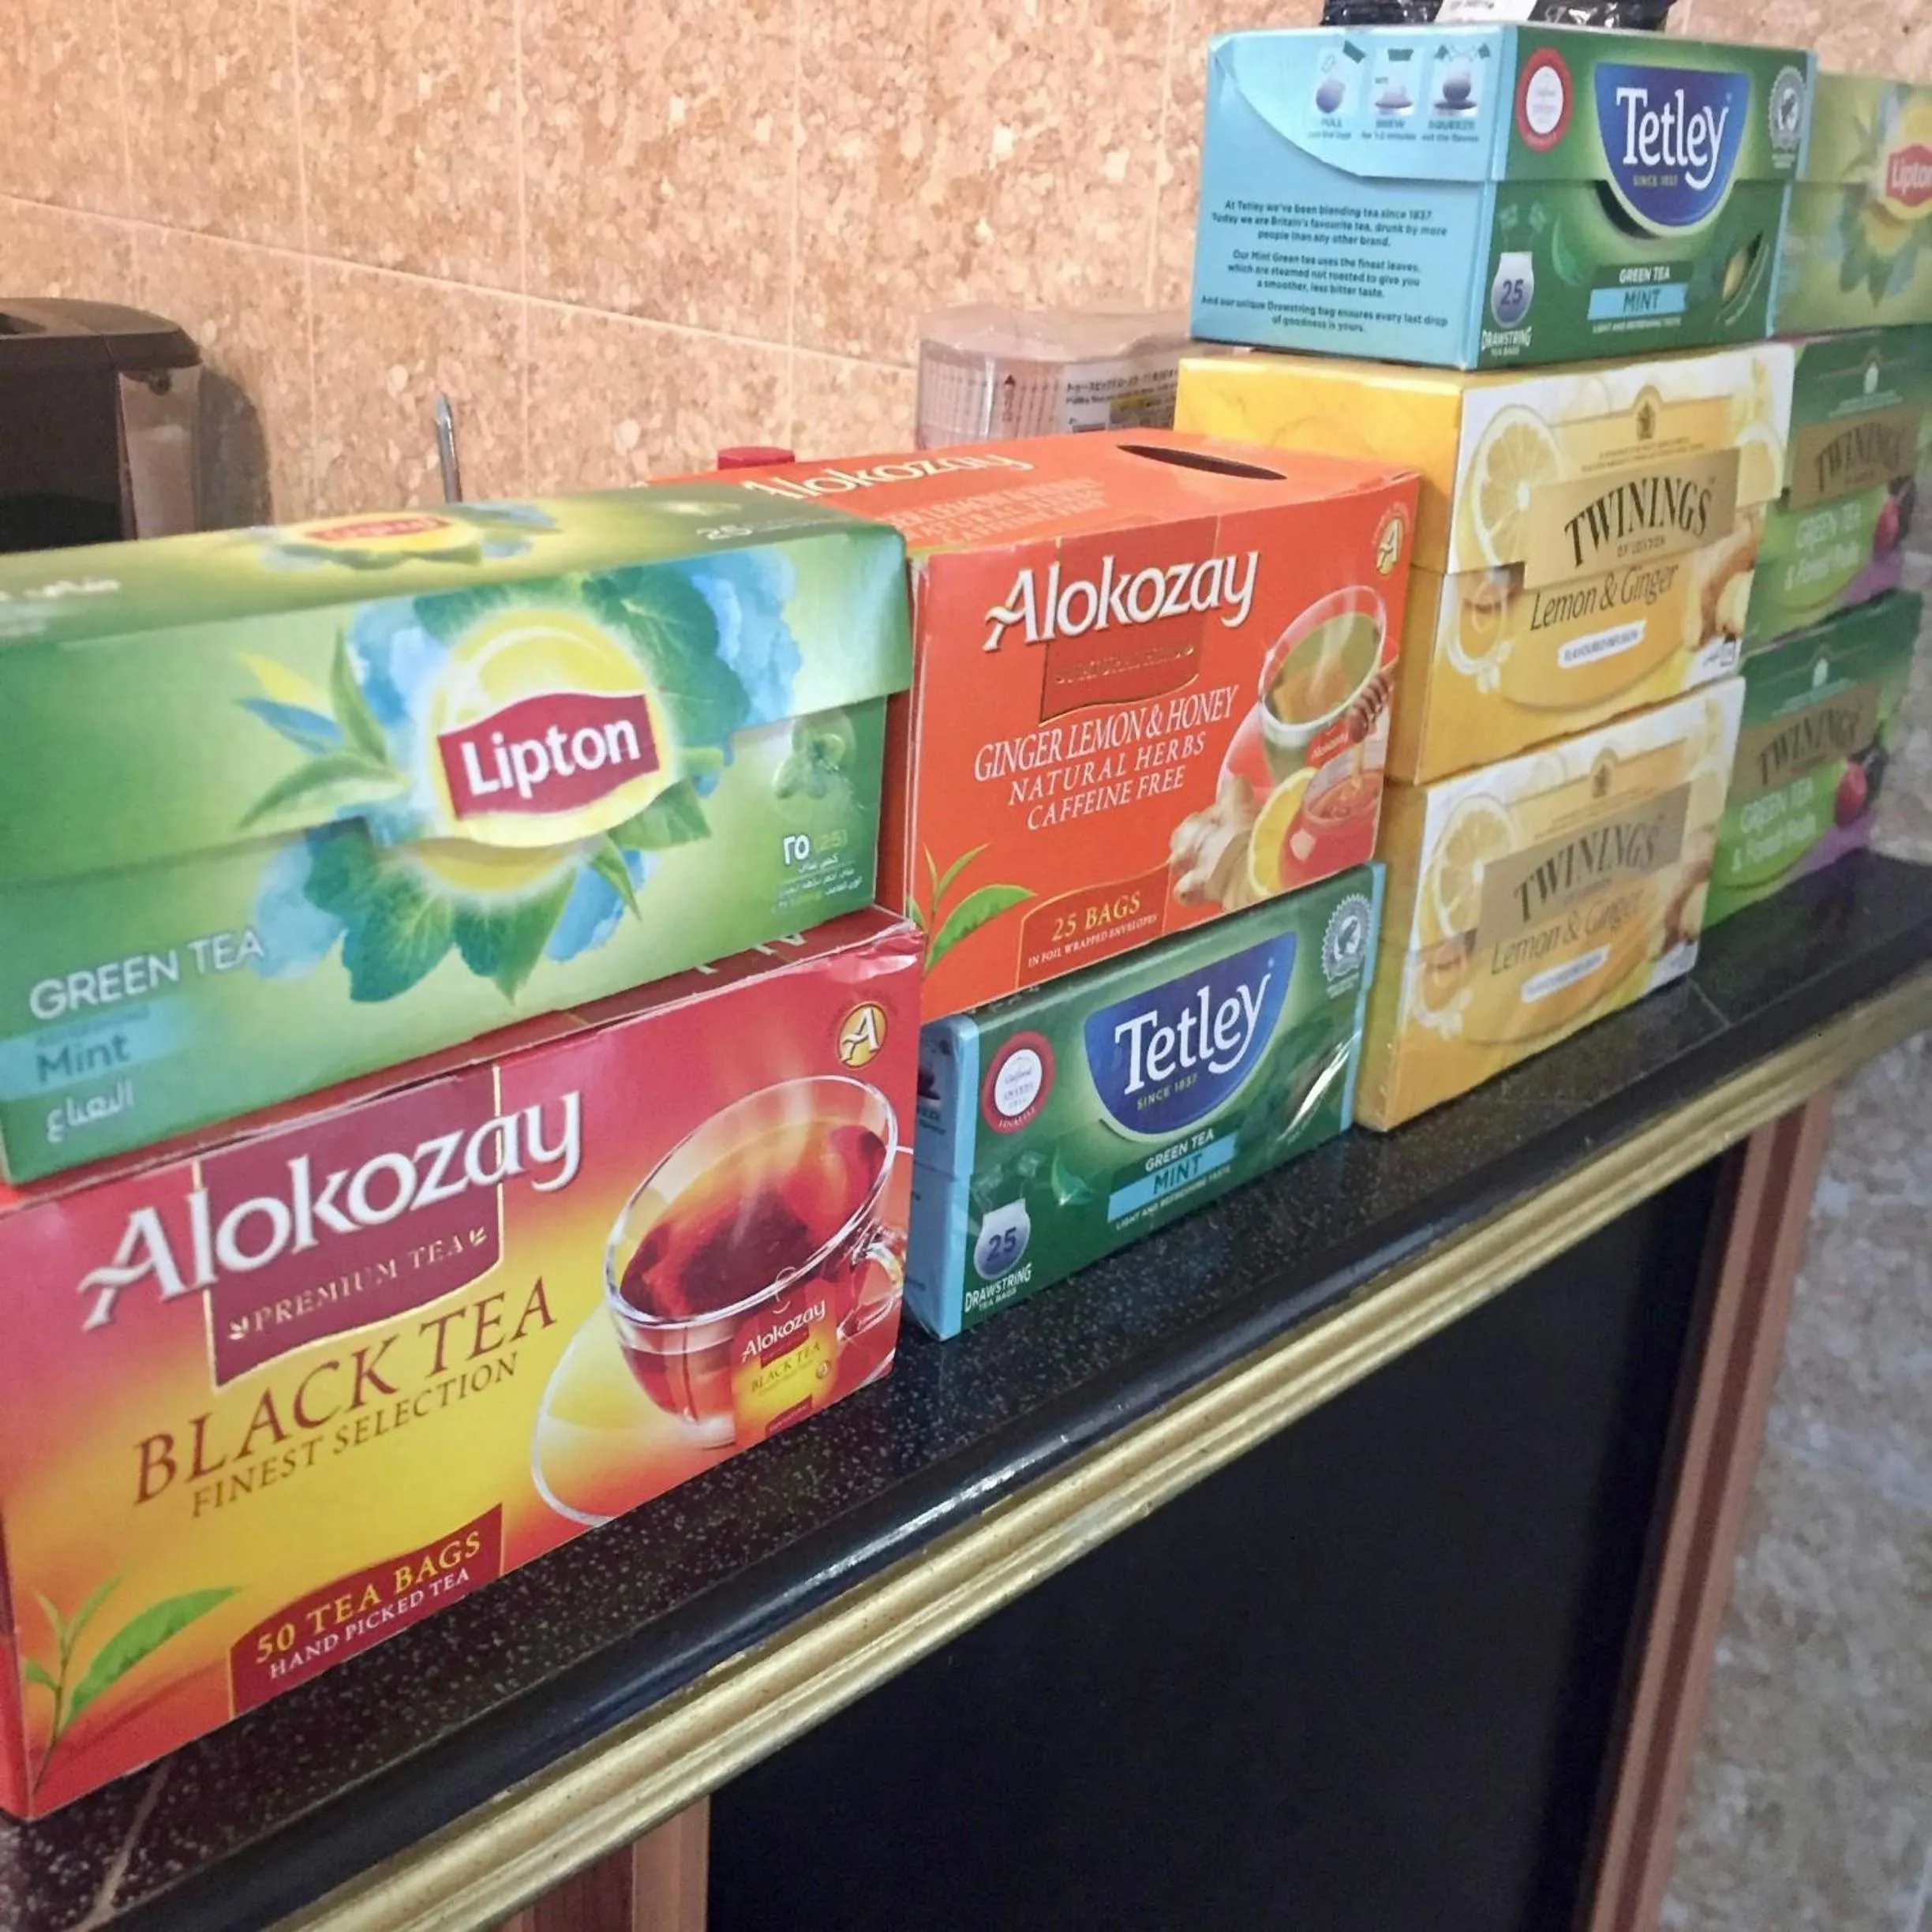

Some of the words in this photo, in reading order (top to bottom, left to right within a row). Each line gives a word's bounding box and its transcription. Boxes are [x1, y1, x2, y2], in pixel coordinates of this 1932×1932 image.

[1616, 86, 1731, 191] Tetley
[1211, 213, 1239, 227] Today
[1240, 216, 1253, 226] we
[1254, 217, 1269, 227] are
[1271, 216, 1309, 229] Britain's
[1310, 219, 1354, 231] favourite
[1375, 223, 1404, 234] drunk
[1405, 223, 1419, 236] by
[1421, 226, 1449, 236] more
[1225, 200, 1235, 211] At
[1237, 200, 1264, 213] Tetley
[1266, 203, 1293, 214] we've
[1294, 204, 1317, 215] been
[1319, 204, 1362, 219] blending
[1363, 208, 1380, 218] tea
[1380, 208, 1407, 219] since
[1232, 249, 1250, 260] Our
[1251, 249, 1271, 262] Mint
[1272, 252, 1300, 264] Green
[1317, 256, 1339, 268] uses
[1340, 256, 1357, 268] the
[1358, 257, 1386, 270] finest
[1257, 229, 1290, 242] people
[1291, 230, 1312, 242] than
[1312, 233, 1331, 245] any
[1332, 233, 1359, 245] other
[1360, 235, 1391, 248] brand.
[1227, 262, 1254, 275] which
[1255, 265, 1270, 275] are
[1271, 266, 1310, 279] steamed
[1311, 268, 1327, 279] not
[1329, 270, 1365, 283] roasted
[1365, 273, 1377, 283] to
[1378, 274, 1400, 287] give
[1402, 276, 1421, 288] you
[1264, 279, 1309, 292] smoother,
[1310, 282, 1329, 294] less
[1330, 283, 1357, 296] bitter
[1358, 286, 1386, 299] taste.
[1500, 278, 1525, 305] 25
[1619, 268, 1652, 283] GREEN
[1652, 265, 1671, 282] TEA
[1201, 294, 1219, 306] And
[1219, 297, 1235, 307] our
[1235, 298, 1267, 312] unique
[1267, 301, 1316, 316] Drawstring
[1318, 304, 1336, 318] bag
[1337, 309, 1374, 321] ensures
[1376, 311, 1402, 325] every
[1403, 312, 1423, 324] last
[1424, 313, 1449, 328] drop
[1271, 315, 1282, 326] of
[1283, 317, 1327, 331] goodness
[1327, 319, 1337, 330] is
[1338, 321, 1365, 334] yours.
[1622, 288, 1661, 313] MINT
[1481, 326, 1532, 353] DRAWSTRING
[1563, 477, 1713, 568] TWININGS
[981, 552, 1260, 653] Alokozay
[1530, 593, 1597, 631] Lemon
[1600, 572, 1618, 612] &
[1620, 564, 1679, 607] Ginger
[459, 719, 641, 799] Lipton
[974, 723, 1063, 782] GINGER
[1065, 709, 1144, 763] LEMON
[1144, 707, 1166, 740] &
[1167, 684, 1240, 731] HONEY
[1007, 759, 1128, 807] NATURAL
[1133, 731, 1207, 773] HERBS
[1026, 782, 1132, 831] CAFFEINE
[1136, 765, 1186, 799] FREE
[1513, 822, 1660, 923] TWININGS
[1028, 954, 1041, 968] IN
[1042, 948, 1062, 964] FOIL
[1064, 929, 1109, 954] WRAPPED
[1108, 912, 1159, 939] ENVELOPES
[1051, 912, 1077, 942] 25
[1085, 890, 1141, 931] BAGS
[28, 947, 179, 1021] GREEN
[186, 928, 267, 975] TEA
[1491, 924, 1560, 975] Lemon
[36, 1034, 131, 1084] Mint
[1114, 971, 1272, 1096] Tetley
[1137, 1087, 1171, 1110] SINCE
[1174, 1073, 1198, 1092] 1837
[1145, 1139, 1189, 1173] GREEN
[1191, 1129, 1215, 1149] TEA
[1153, 1153, 1203, 1195] MINT
[77, 1090, 582, 1334] Alokozay
[1116, 1211, 1140, 1230] LIGHT
[1141, 1204, 1159, 1216] AND
[987, 1226, 1017, 1263] 25
[251, 1259, 398, 1335] PREMIUM
[407, 1237, 463, 1272] TEA
[964, 1260, 1032, 1313] DRAWSTRING
[979, 1298, 994, 1312] TEA
[994, 1286, 1017, 1304] BAGS
[741, 1300, 826, 1363] Alokozay
[133, 1335, 401, 1505] BLACK
[418, 1275, 558, 1380] TEA
[751, 1356, 792, 1393] BLACK
[796, 1341, 822, 1363] TEA
[190, 1436, 324, 1520] FINEST
[331, 1350, 519, 1457] SELECTION
[255, 1623, 297, 1665] 50
[308, 1585, 383, 1634] TEA
[391, 1530, 484, 1597] BAGS
[268, 1632, 341, 1682] HAND
[345, 1589, 425, 1645] PICKED
[427, 1567, 471, 1599] TEA
